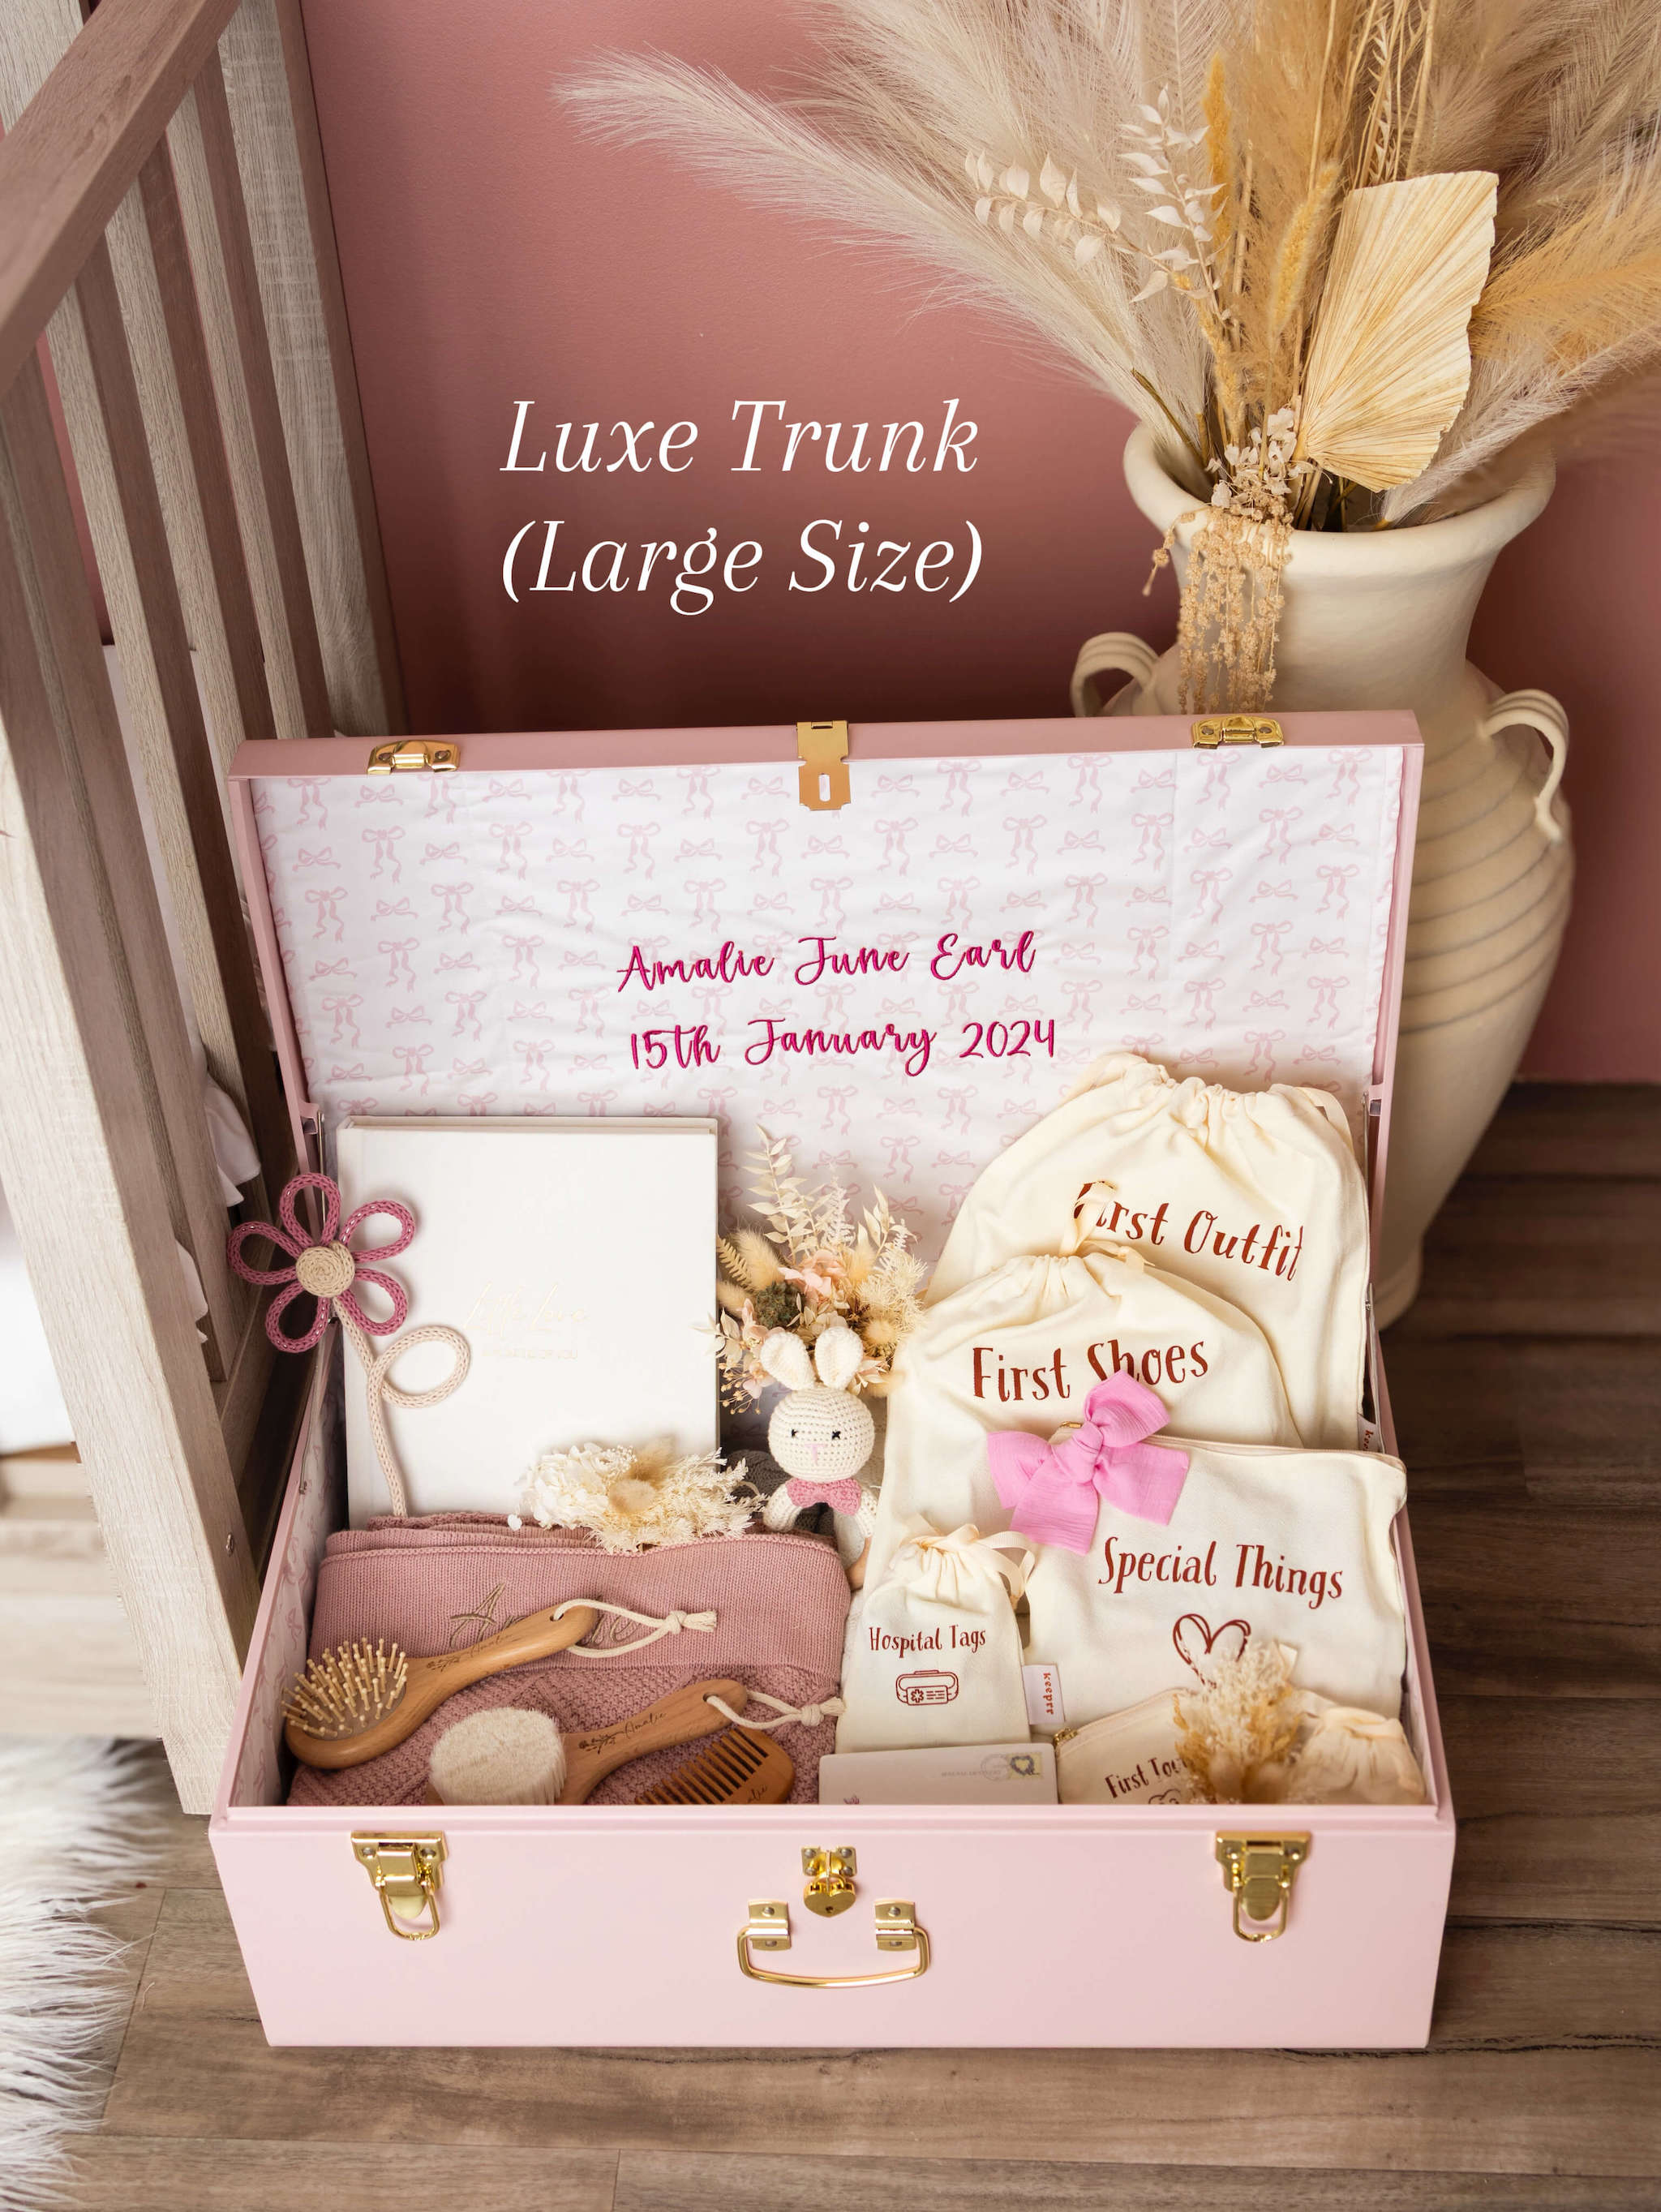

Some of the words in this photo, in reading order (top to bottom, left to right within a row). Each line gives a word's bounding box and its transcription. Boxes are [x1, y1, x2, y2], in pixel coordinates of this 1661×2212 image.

[617, 940, 775, 992] Amalie
[794, 936, 910, 986] June
[929, 930, 1037, 981] Earl
[630, 1024, 720, 1070] 15th
[744, 1018, 937, 1077] January
[959, 1019, 1055, 1059] 2024
[1183, 1210, 1303, 1282] Outfit
[972, 1347, 1071, 1402] First
[1087, 1338, 1208, 1386] Shoes
[1097, 1536, 1217, 1594] Special
[1234, 1544, 1343, 1609] Things
[869, 1627, 942, 1659] Hospital
[951, 1625, 986, 1652] Tags
[1043, 1673, 1054, 1715] keeprr
[1105, 1763, 1148, 1798] First
